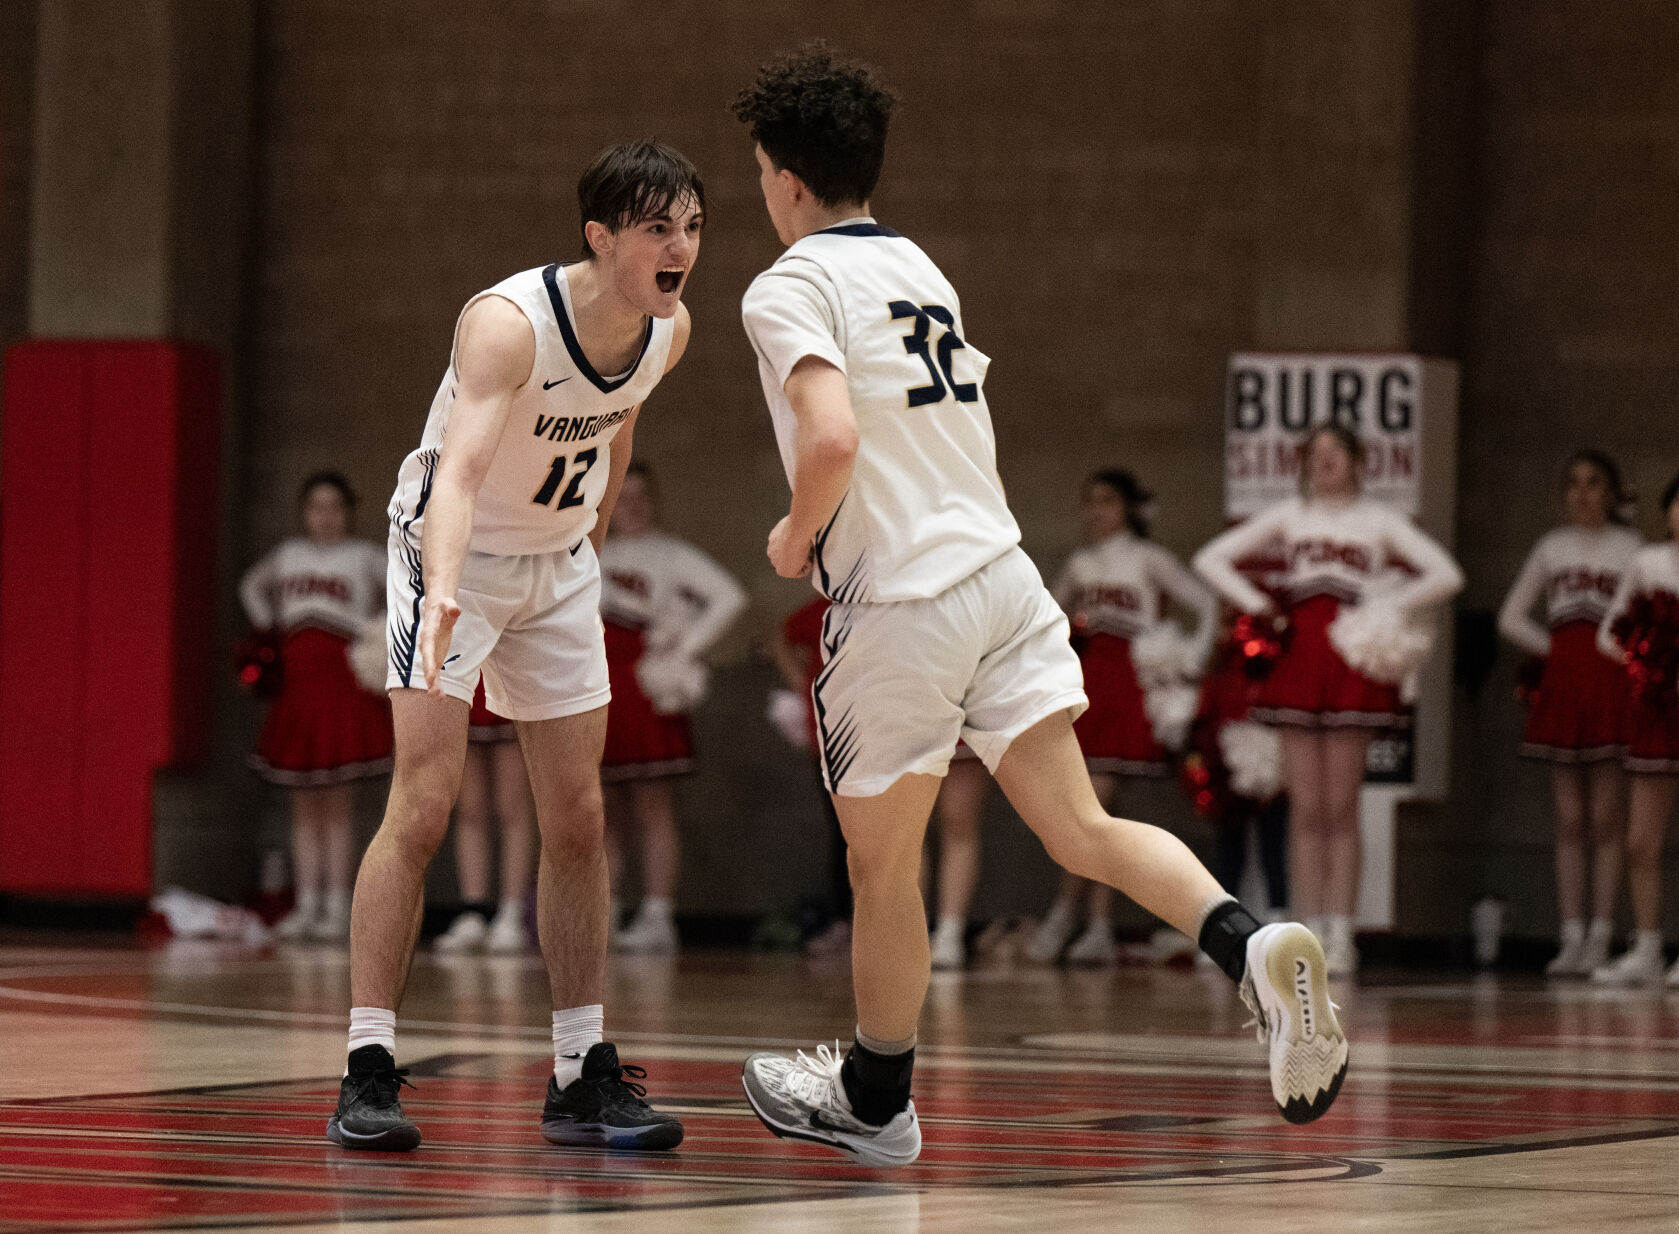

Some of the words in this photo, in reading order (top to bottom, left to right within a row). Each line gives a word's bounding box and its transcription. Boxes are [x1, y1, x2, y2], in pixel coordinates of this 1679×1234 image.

[886, 299, 979, 409] 32
[1234, 368, 1412, 432] BURG
[530, 446, 598, 512] 12
[1227, 442, 1414, 477] SIMON
